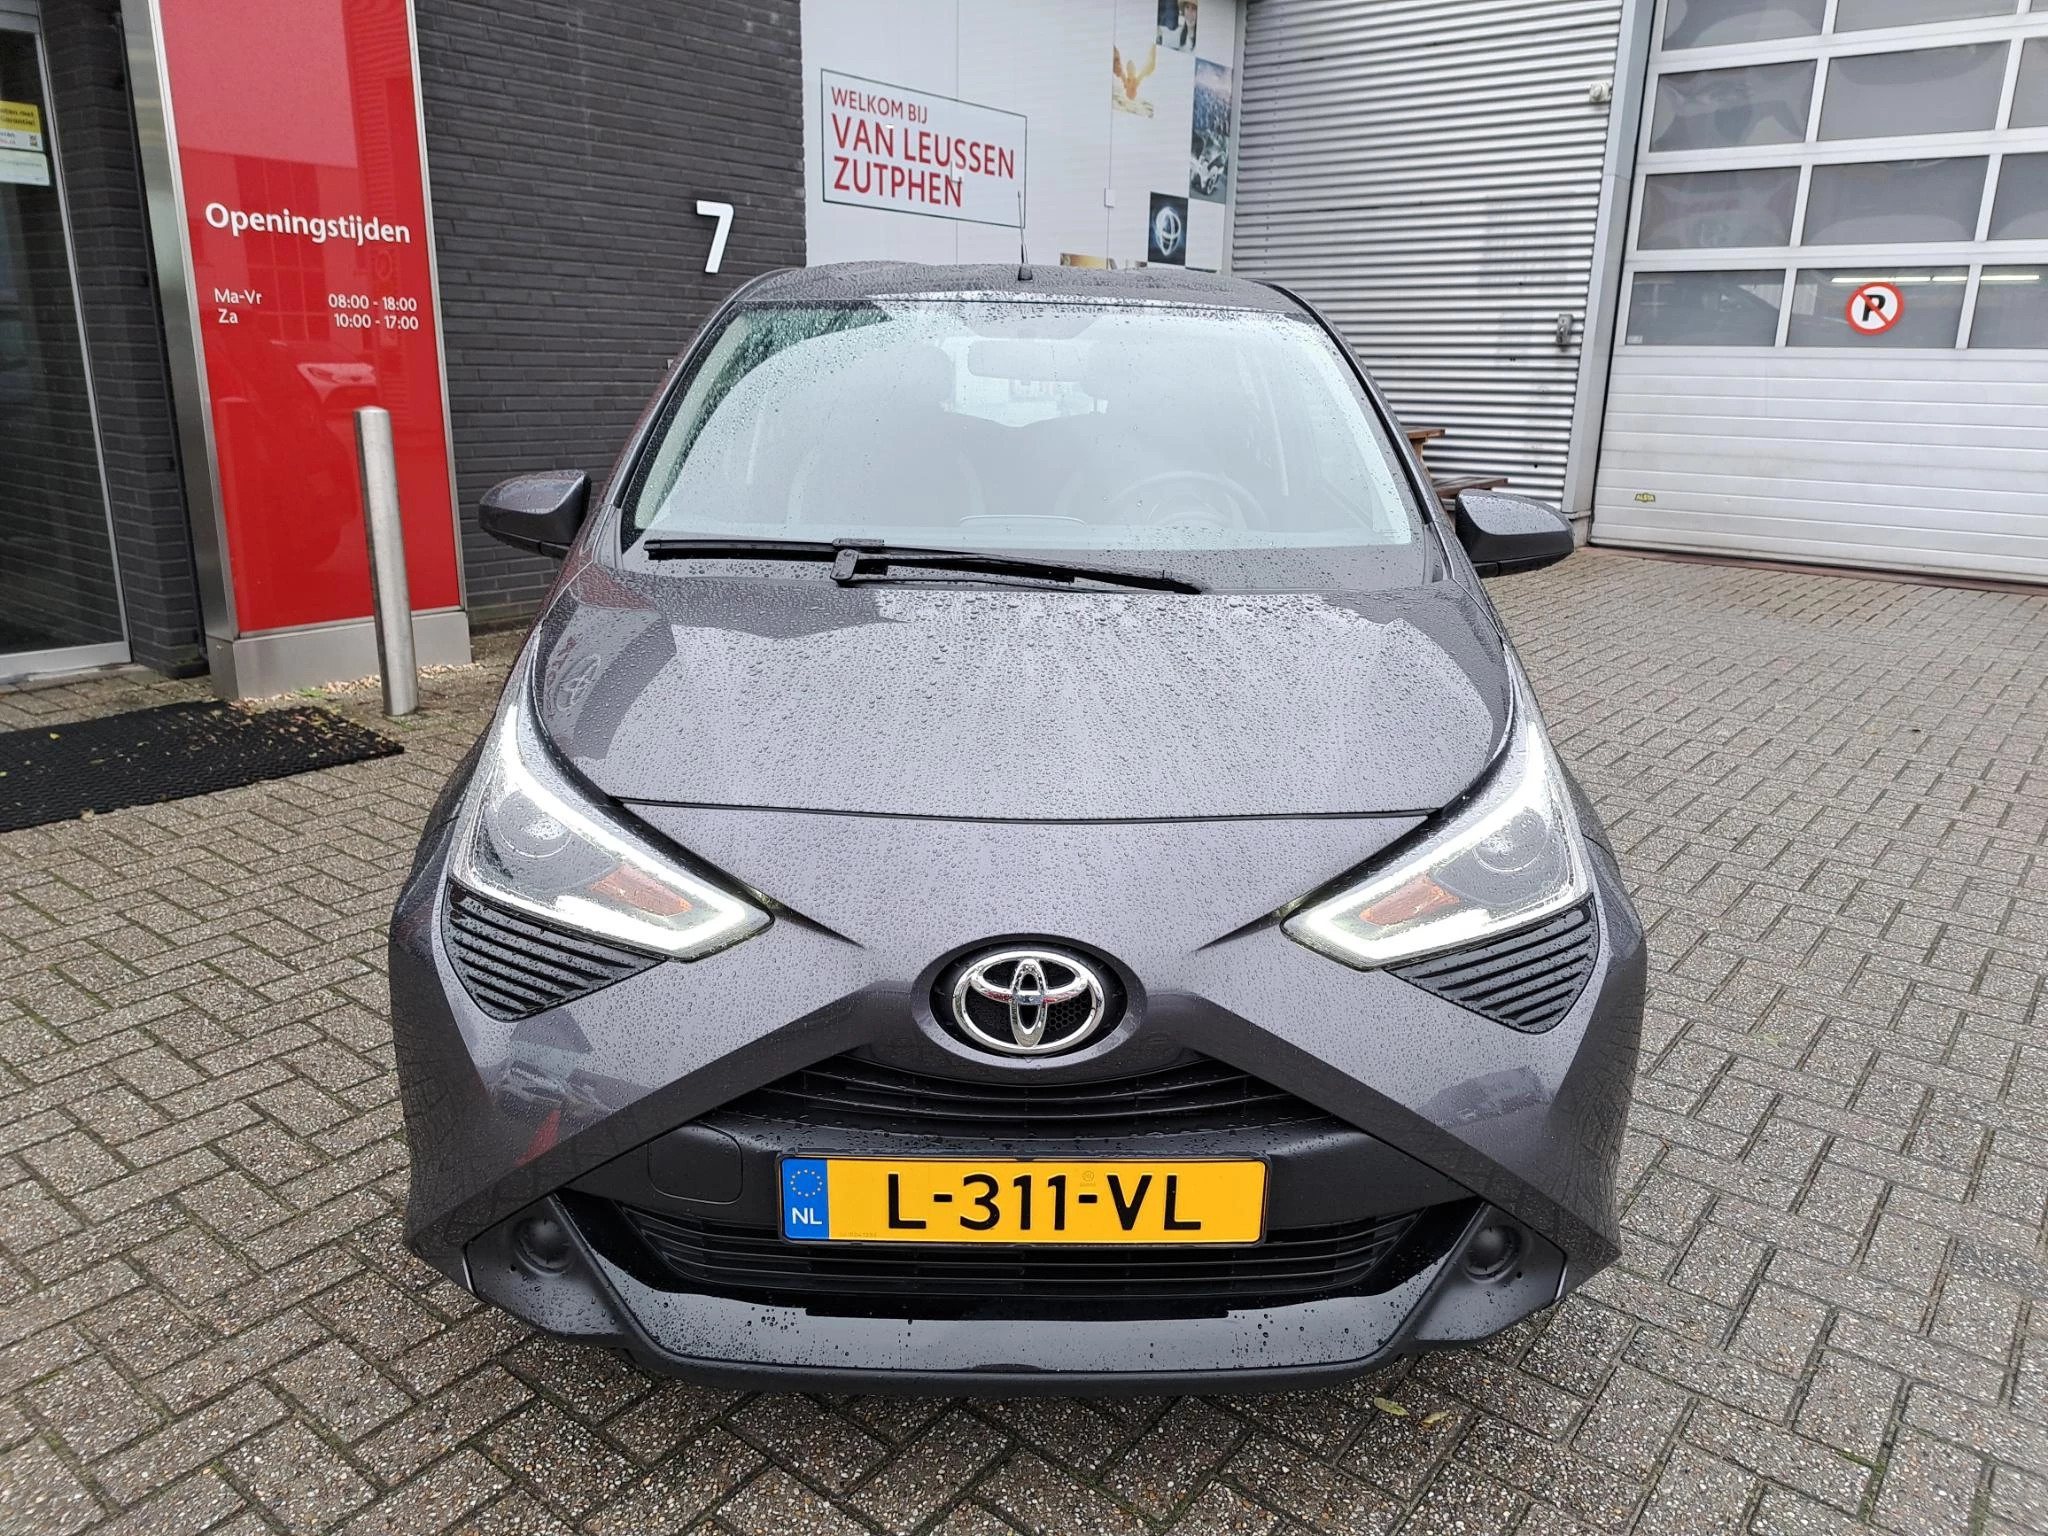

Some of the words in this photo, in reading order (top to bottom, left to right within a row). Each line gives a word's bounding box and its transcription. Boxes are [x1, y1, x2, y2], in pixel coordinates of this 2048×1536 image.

[831, 86, 903, 118] WELKOM
[908, 103, 928, 125] BIJ
[831, 113, 894, 158] VAN
[903, 128, 1015, 179] LEUSSEN
[833, 155, 962, 208] ZUTPHEN
[205, 202, 411, 246] Openingstijden
[696, 200, 734, 273] 7
[214, 288, 262, 305] Ma-Vr
[218, 308, 239, 324] Za
[328, 293, 369, 310] 08:00
[382, 296, 417, 311] 18:00
[334, 313, 371, 329] 10:00
[384, 315, 419, 330] 17:00
[791, 1207, 823, 1225] NL
[887, 1173, 1202, 1231] L-311-VL
